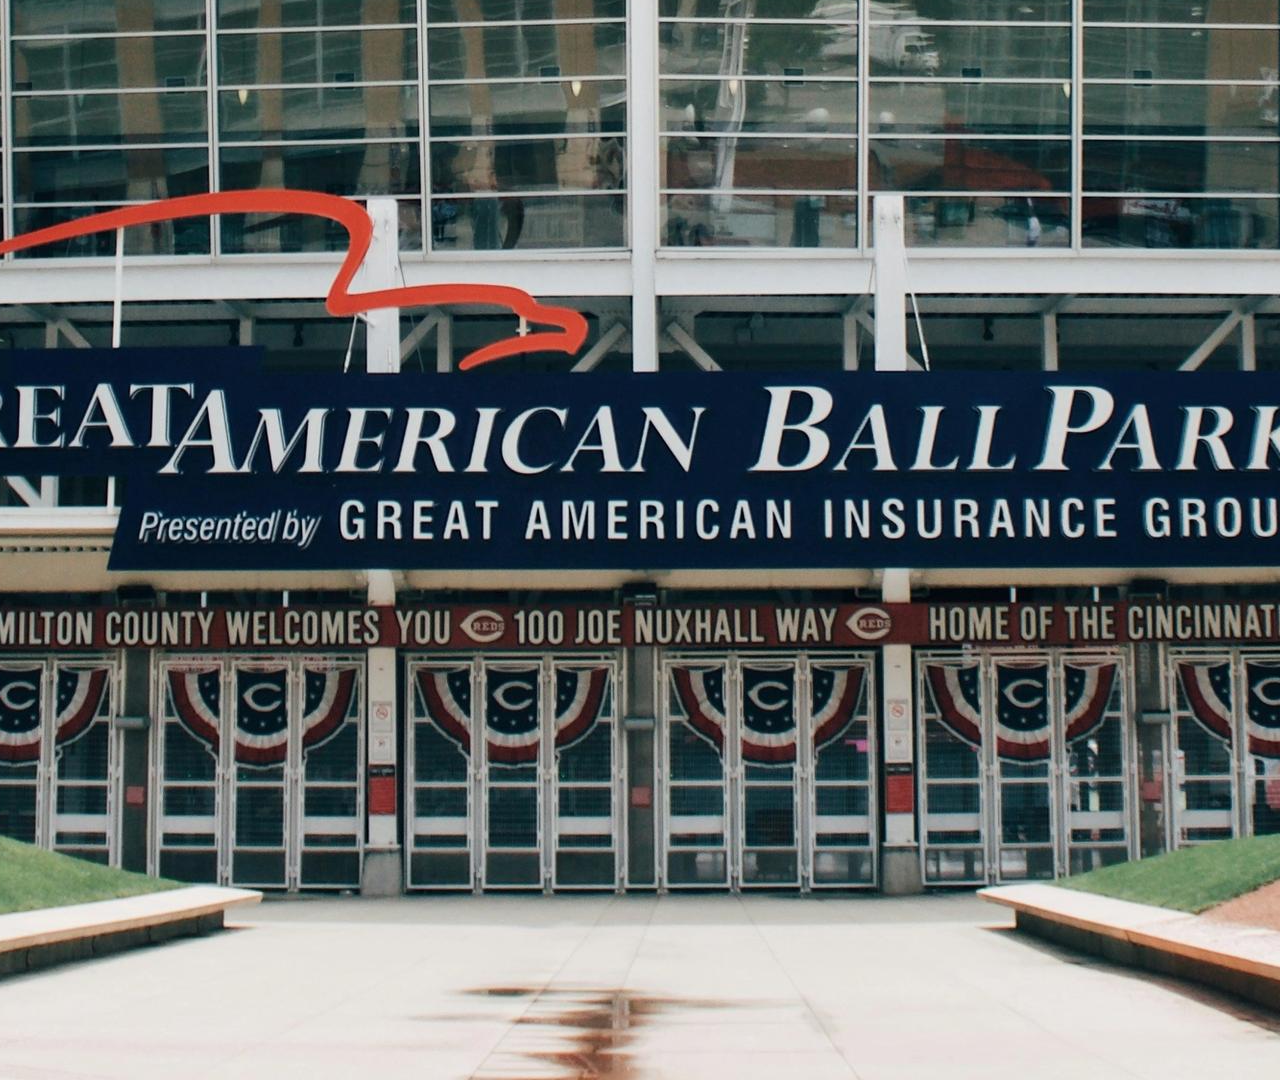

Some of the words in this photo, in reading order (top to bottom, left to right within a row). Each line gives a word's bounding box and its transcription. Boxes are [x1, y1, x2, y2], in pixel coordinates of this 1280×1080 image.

[157, 389, 705, 475] AMERICAN
[747, 385, 1017, 473] BALL
[138, 507, 282, 544] Presented
[282, 508, 322, 549] by
[339, 499, 500, 541] GREAT
[524, 498, 793, 540] AMERICAN
[824, 498, 1118, 540] INSURANCE
[105, 610, 215, 645] COUNTY
[226, 610, 380, 645] WELCOMES
[396, 609, 451, 645] YOU
[472, 621, 505, 632] REDS
[514, 609, 564, 645] 100
[574, 609, 621, 645] JOE
[635, 608, 765, 643] NUXHALL
[776, 607, 837, 642] WAY
[857, 617, 892, 629] REDS
[929, 606, 1009, 641] HOME
[1020, 606, 1053, 640] OF
[1064, 606, 1116, 640] THE
